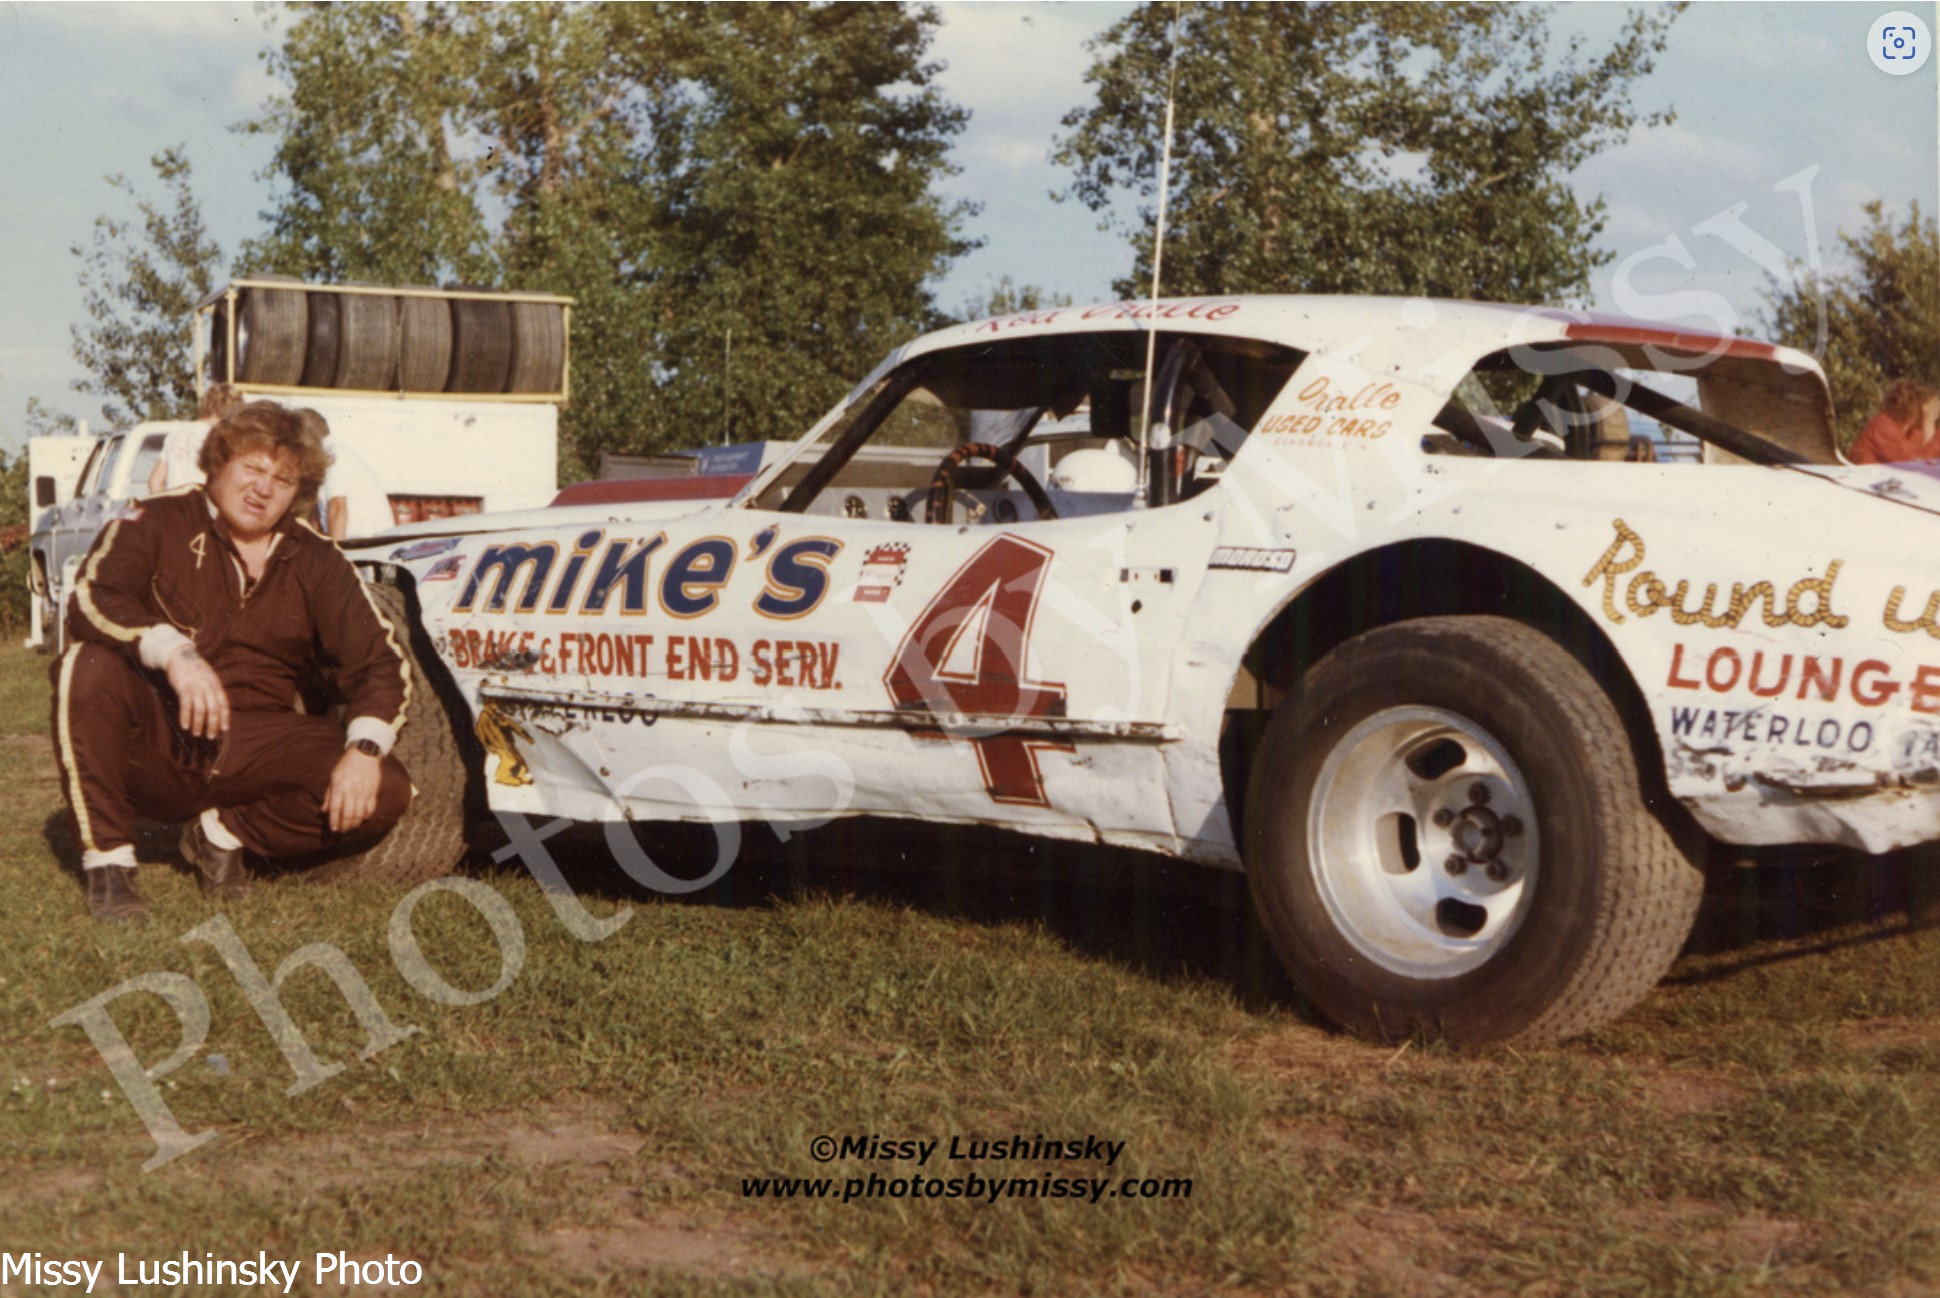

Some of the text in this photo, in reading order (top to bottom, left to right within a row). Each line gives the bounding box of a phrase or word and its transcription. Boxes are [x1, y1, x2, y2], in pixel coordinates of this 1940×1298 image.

[1260, 414, 1393, 441] USED CARS
[189, 531, 206, 569] 4
[1582, 517, 1849, 629] Round
[447, 628, 536, 674] BRAKE
[558, 632, 655, 678] FRONT
[666, 634, 739, 683] END
[752, 638, 844, 691] SERV.
[882, 531, 1077, 808] 4
[1666, 643, 1940, 715] LOUNGE
[1670, 705, 1874, 752] WATERLOO
